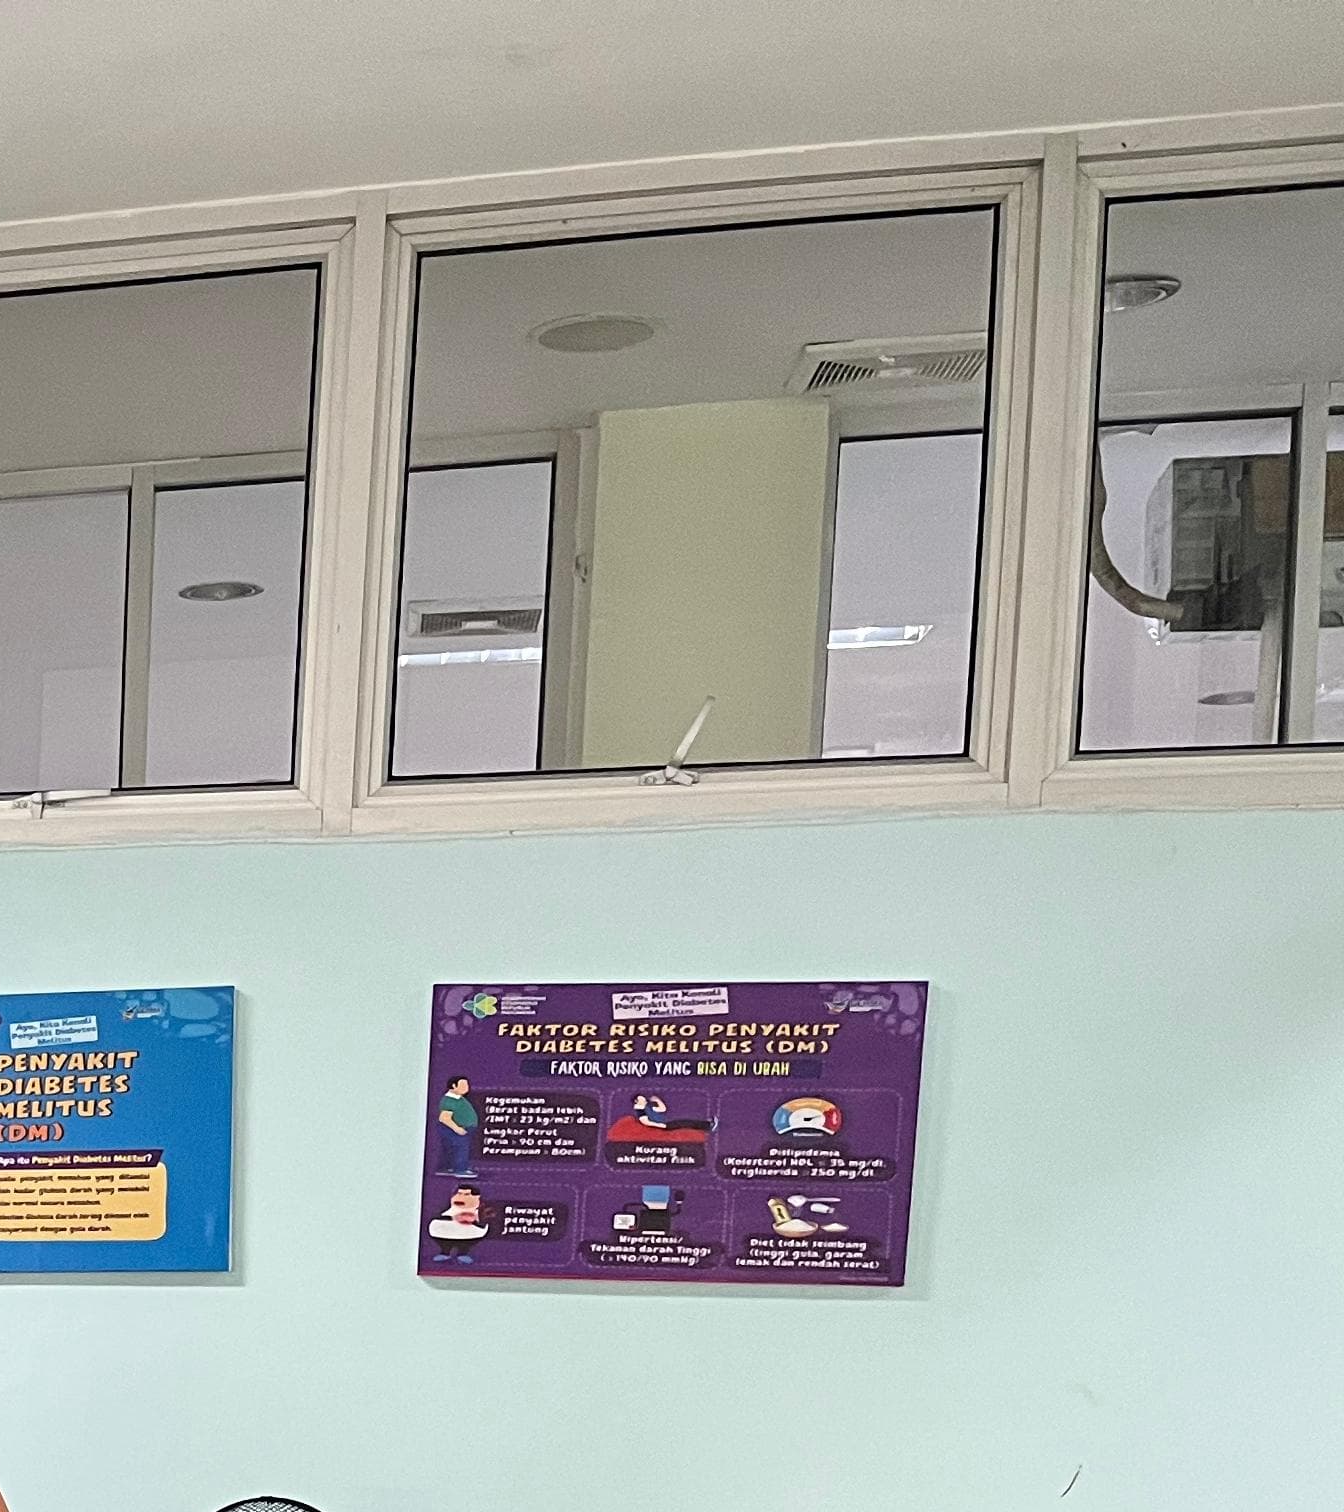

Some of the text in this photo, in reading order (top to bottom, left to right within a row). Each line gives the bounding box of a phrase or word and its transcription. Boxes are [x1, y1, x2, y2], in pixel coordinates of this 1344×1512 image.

[651, 992, 679, 1000] Kita
[681, 989, 722, 998] Kenali
[614, 998, 727, 1012] Penyakit Diabetes
[497, 1022, 840, 1037] FAKTOR RISIKO PENYAKIT
[515, 1039, 830, 1053] DIABETES MELITUS (DM)
[550, 1060, 790, 1078] FAKTOR RISIKO YANG BISA DI UBAH
[485, 1096, 546, 1106] Kegemukan
[521, 1106, 554, 1114] badan
[556, 1106, 584, 1114] lebih
[576, 1116, 597, 1124] dan
[483, 1127, 558, 1138] Lingkar Perut
[519, 1138, 535, 1146] 90
[537, 1138, 552, 1146] cm
[554, 1138, 575, 1146] dan
[482, 1147, 541, 1156] Perempuan
[635, 1146, 678, 1156] Kurang
[17, 1156, 30, 1165] itu
[31, 1155, 71, 1167] Penyakit
[73, 1154, 112, 1164] Diabetes
[113, 1153, 153, 1163] Melitus?
[616, 1156, 695, 1164] aktivitas fisik
[790, 1158, 814, 1166] HDL
[504, 1206, 554, 1217] Riwayat
[504, 1217, 556, 1226] penyakit
[501, 1226, 549, 1236] jantung
[749, 1238, 867, 1251] Diet tidak seimbang
[590, 1244, 712, 1257] Tekanan darah Tinggi
[735, 1258, 770, 1267] lemak
[773, 1258, 795, 1267] dan
[798, 1259, 841, 1268] rendah
